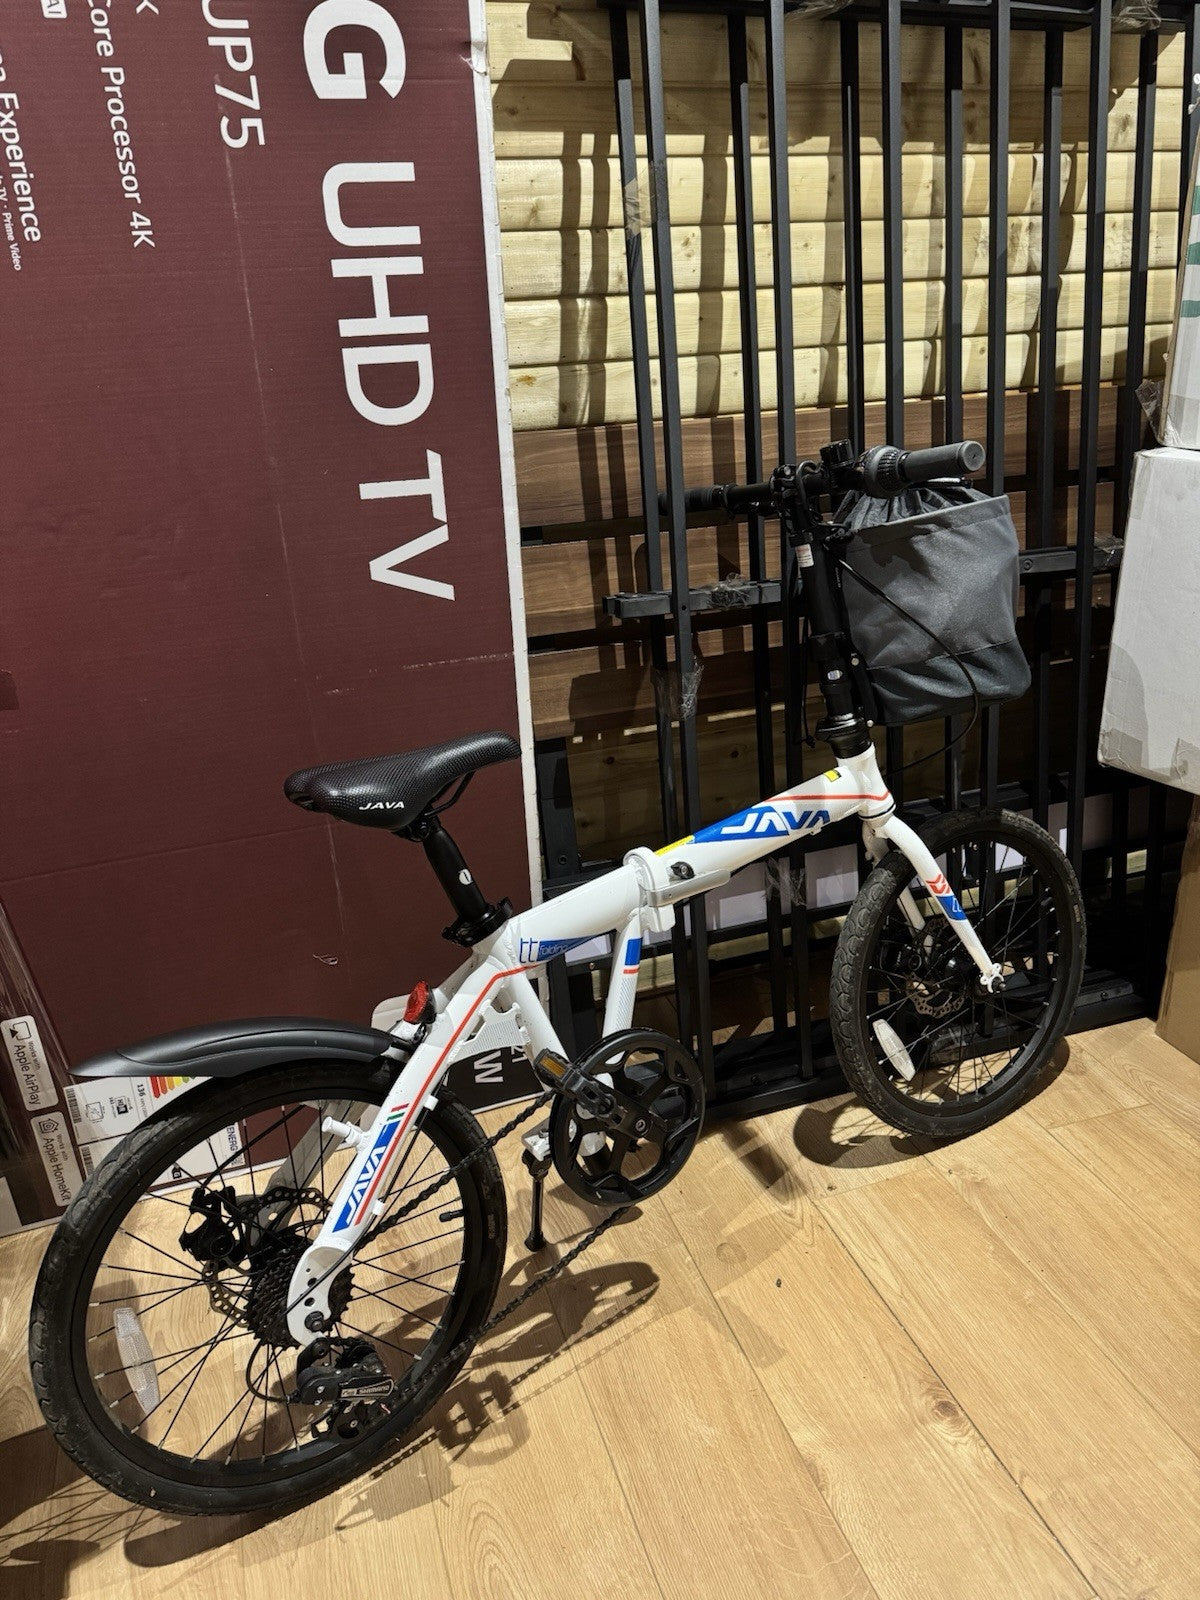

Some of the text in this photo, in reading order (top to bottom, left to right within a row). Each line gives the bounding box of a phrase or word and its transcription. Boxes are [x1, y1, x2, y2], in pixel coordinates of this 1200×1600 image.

[87, 0, 156, 248] ore Processor 4K
[0, 93, 42, 242] Experience
[2, 212, 15, 241] Prime
[9, 243, 22, 271] Video
[322, 161, 435, 426] UHD
[358, 448, 456, 602] TV
[359, 801, 405, 811] JAVA
[720, 810, 831, 835] JAVA
[14, 1044, 41, 1105] Apple AirPlay
[28, 1041, 37, 1059] Works
[42, 1137, 71, 1201] Apple HomeKit
[226, 1126, 239, 1152] ENERG
[344, 1145, 387, 1226] JAVA
